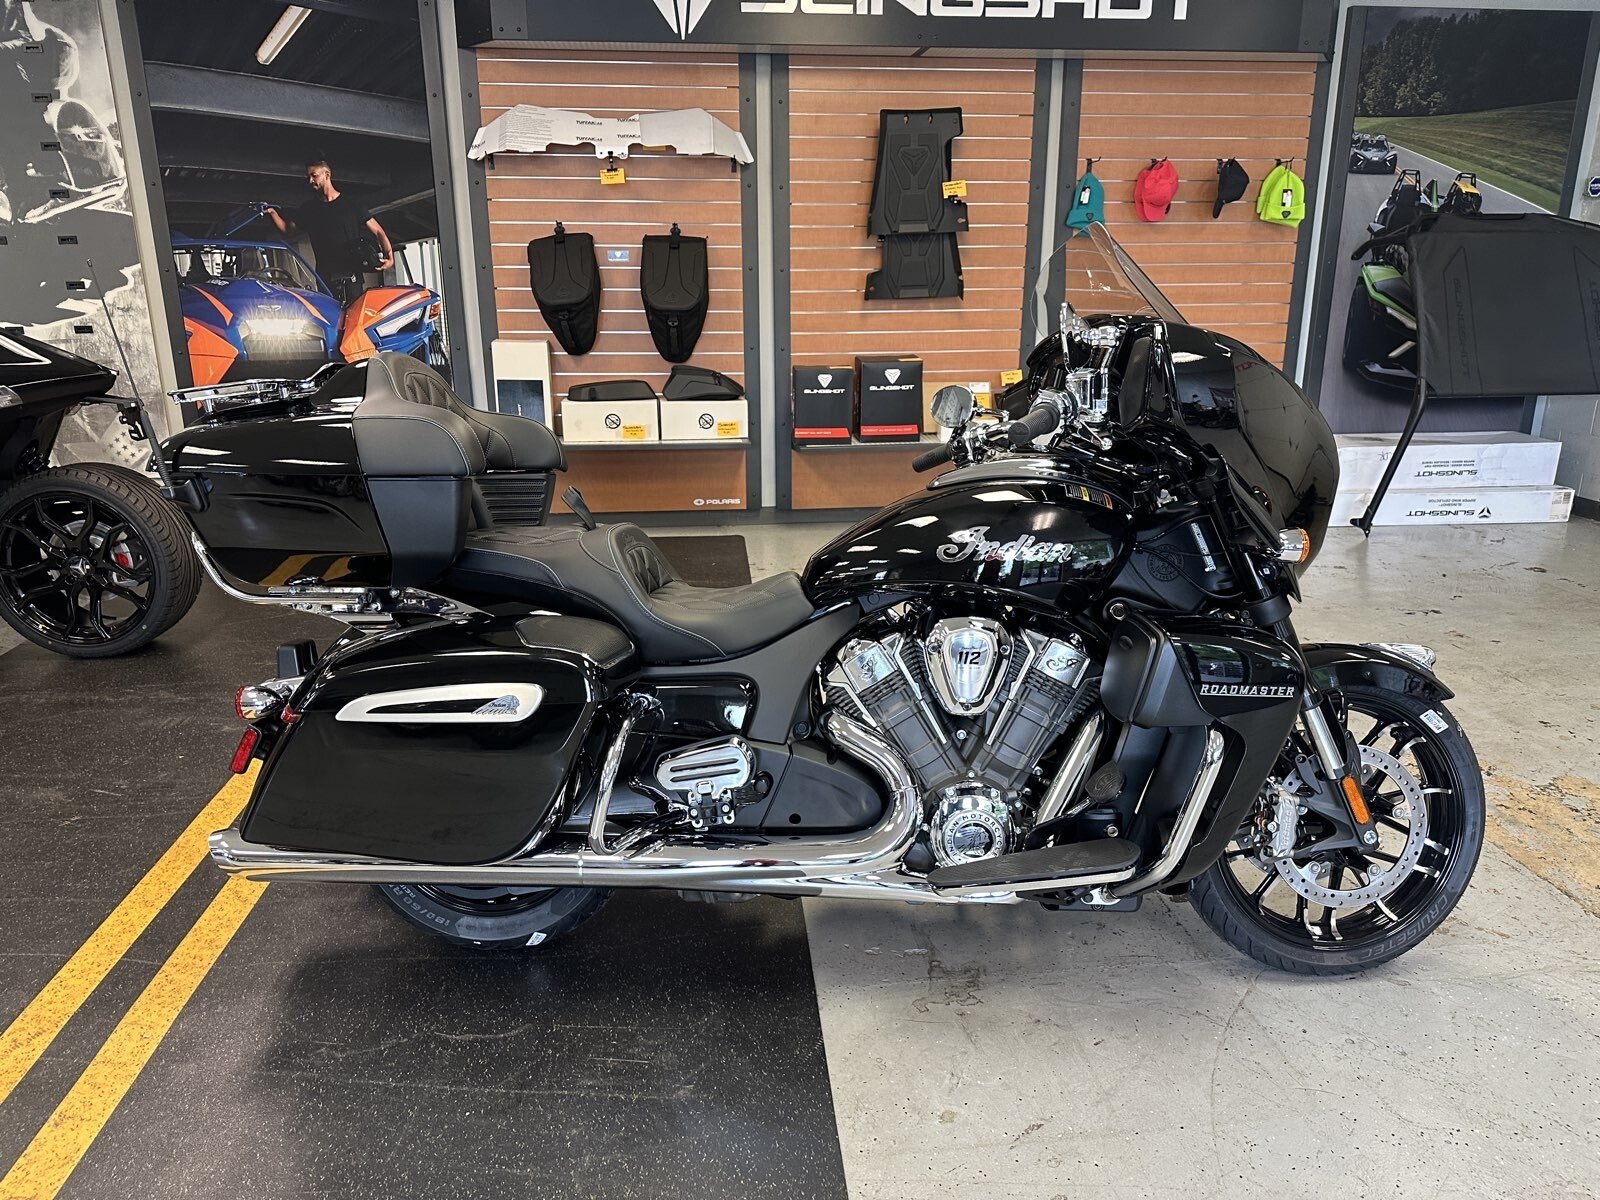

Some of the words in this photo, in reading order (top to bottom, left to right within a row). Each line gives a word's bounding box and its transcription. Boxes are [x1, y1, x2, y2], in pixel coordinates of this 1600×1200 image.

[1414, 469, 1478, 478] SLINGSHOT
[1406, 509, 1476, 517] SLINGSHOT
[936, 526, 1074, 563] Indian
[957, 650, 981, 665] 112
[1200, 684, 1294, 697] ROADMASTER
[947, 821, 960, 857] INDIAN
[962, 813, 1003, 857] MOTORCYCLE
[403, 896, 450, 927] 180/60
[1361, 895, 1448, 959] CRUISETEC
